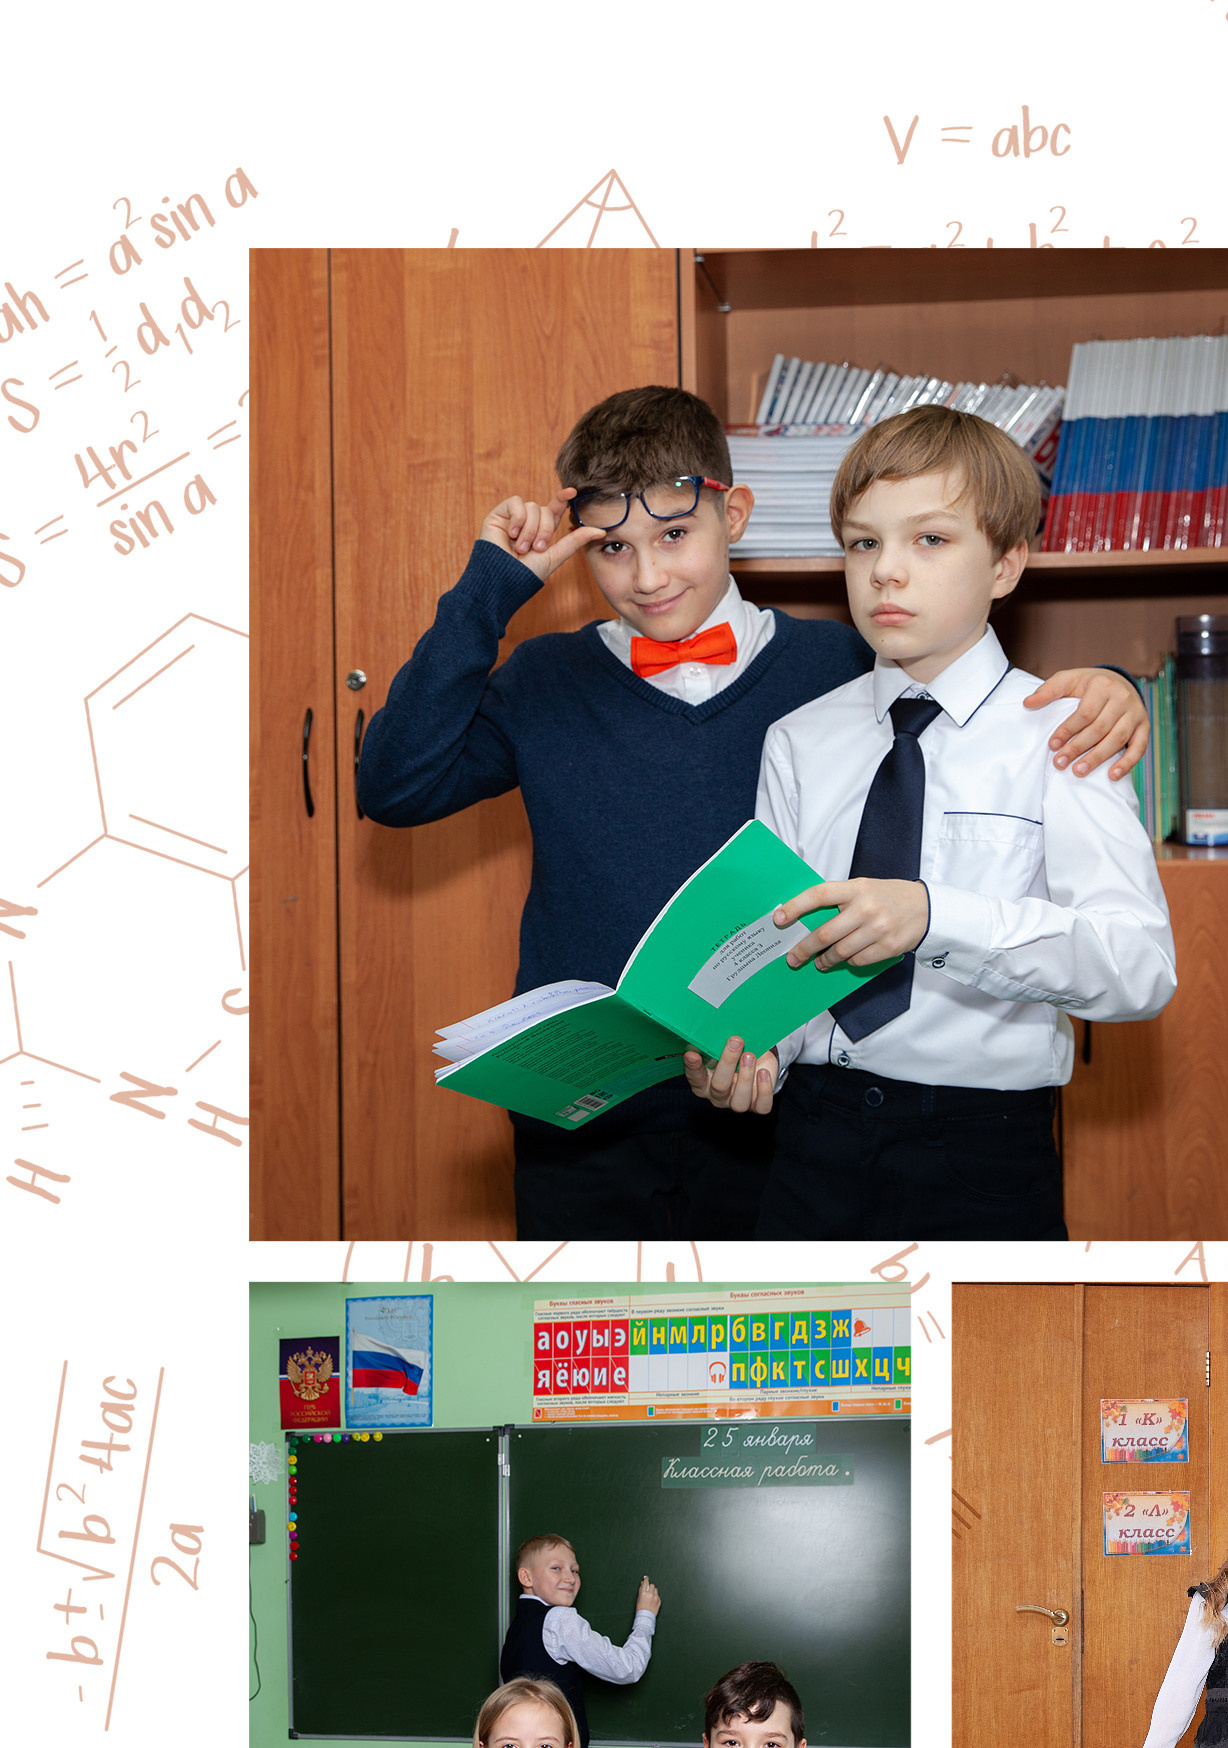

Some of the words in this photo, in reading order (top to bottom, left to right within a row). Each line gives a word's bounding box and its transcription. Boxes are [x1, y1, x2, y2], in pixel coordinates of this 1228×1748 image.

[711, 922, 746, 952] ТЕТРАДЬ
[729, 1291, 749, 1299] Буквы
[750, 1290, 782, 1298] согласных
[783, 1289, 805, 1297] звуков
[1118, 1413, 1127, 1426] 1
[742, 1426, 814, 1454] января
[1112, 1436, 1169, 1448] класс
[663, 1457, 755, 1479] Классная
[1124, 1504, 1135, 1518] 2
[1118, 1527, 1175, 1539] класс
